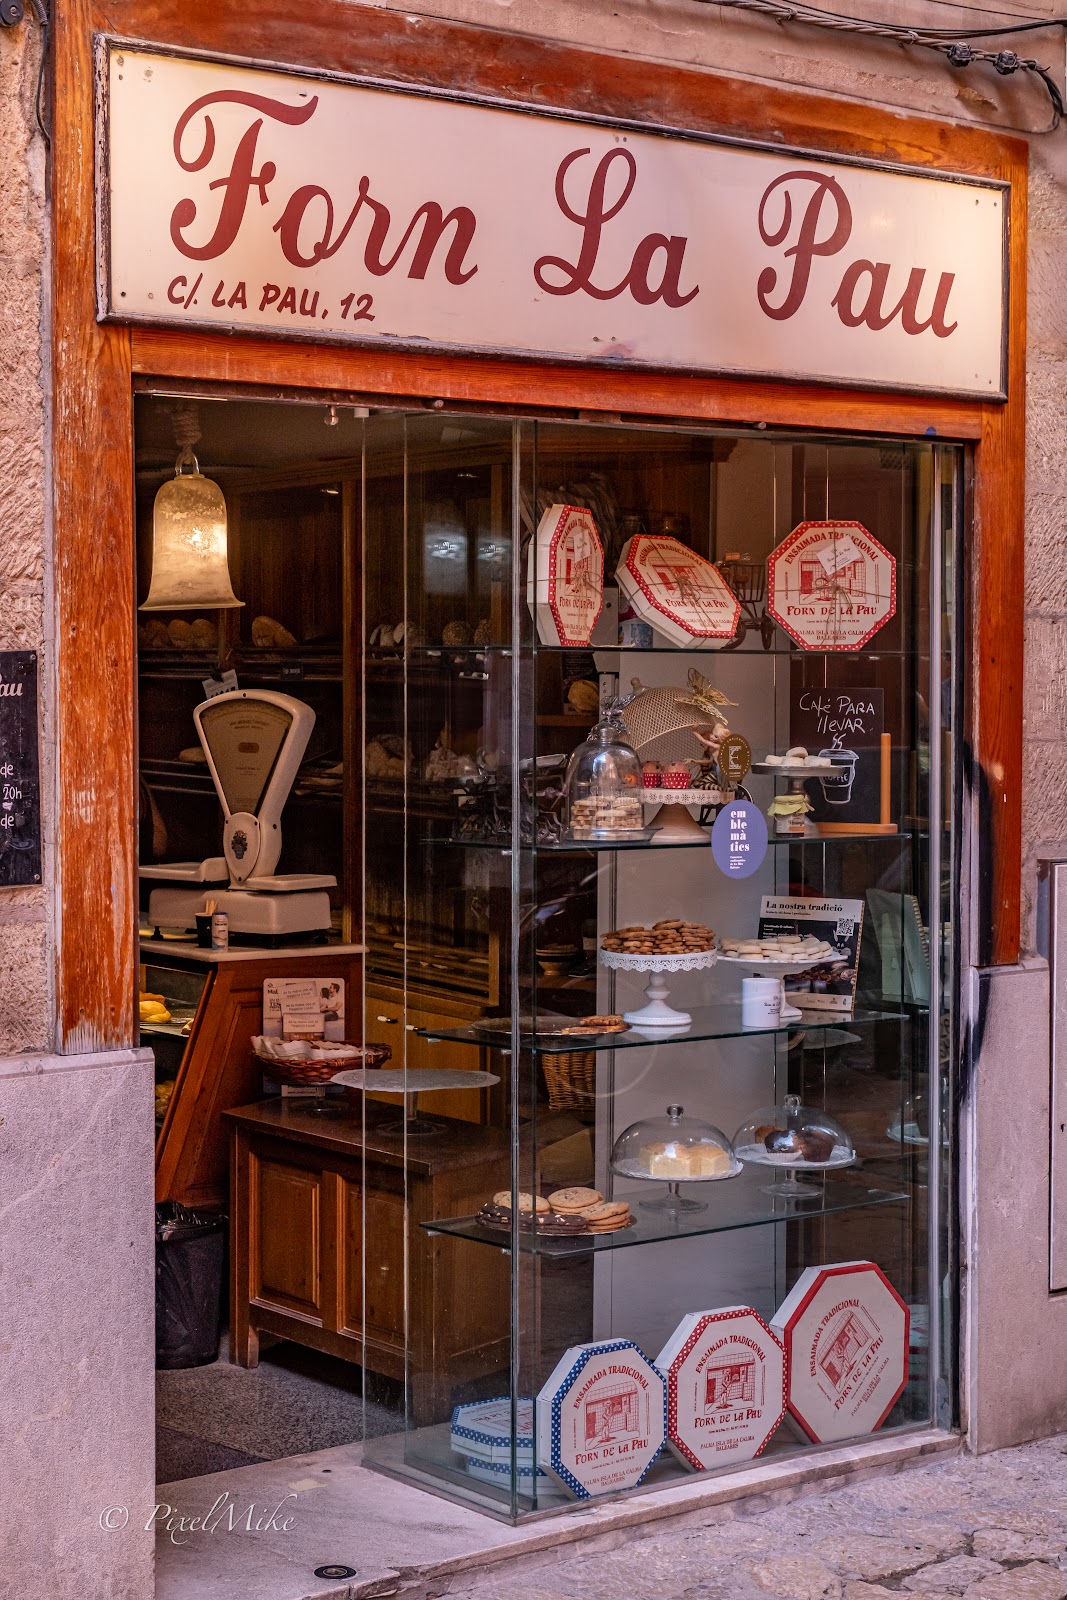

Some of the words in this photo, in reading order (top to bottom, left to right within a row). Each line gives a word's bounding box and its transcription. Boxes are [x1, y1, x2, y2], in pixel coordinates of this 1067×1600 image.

[170, 89, 478, 285] Forn
[533, 147, 699, 308] La
[757, 170, 957, 337] Pau
[211, 280, 248, 309] LA
[259, 283, 329, 319] PAU,
[340, 292, 375, 321] 12
[784, 532, 827, 564] ENSAIMADA
[787, 605, 815, 616] FORN
[821, 606, 835, 615] DE
[840, 606, 853, 615] LA
[856, 604, 877, 615] PAU
[0, 677, 24, 697] au
[836, 695, 875, 715] PARA
[730, 810, 746, 818] em
[730, 819, 747, 830] ble
[730, 830, 746, 840] mà
[730, 841, 750, 852] tics
[766, 901, 777, 909] La
[779, 902, 806, 910] nostra
[808, 904, 843, 912] tradició
[810, 1327, 824, 1377] ENSAIMADA
[821, 1299, 860, 1327] TRADICIONAL
[695, 1337, 728, 1374] ENSAIMADA
[730, 1335, 766, 1362] TRADICIONAL
[834, 1384, 852, 1410] FORN
[852, 1368, 862, 1383] DE
[862, 1354, 871, 1368] LA
[869, 1335, 884, 1355] PAU
[878, 1357, 890, 1374] CALMA
[573, 1369, 607, 1410] ENSAIMADA
[608, 1365, 649, 1391] TRADICIONAL
[694, 1417, 716, 1428] FORN
[719, 1413, 731, 1424] DE
[734, 1412, 744, 1421] LA
[746, 1408, 762, 1419] PAU
[575, 1451, 599, 1465] FORN
[603, 1447, 614, 1458] DE
[618, 1443, 630, 1453] LA
[631, 1439, 649, 1451] PAU
[583, 1476, 600, 1486] PALMA
[626, 1466, 643, 1475] CALMA
